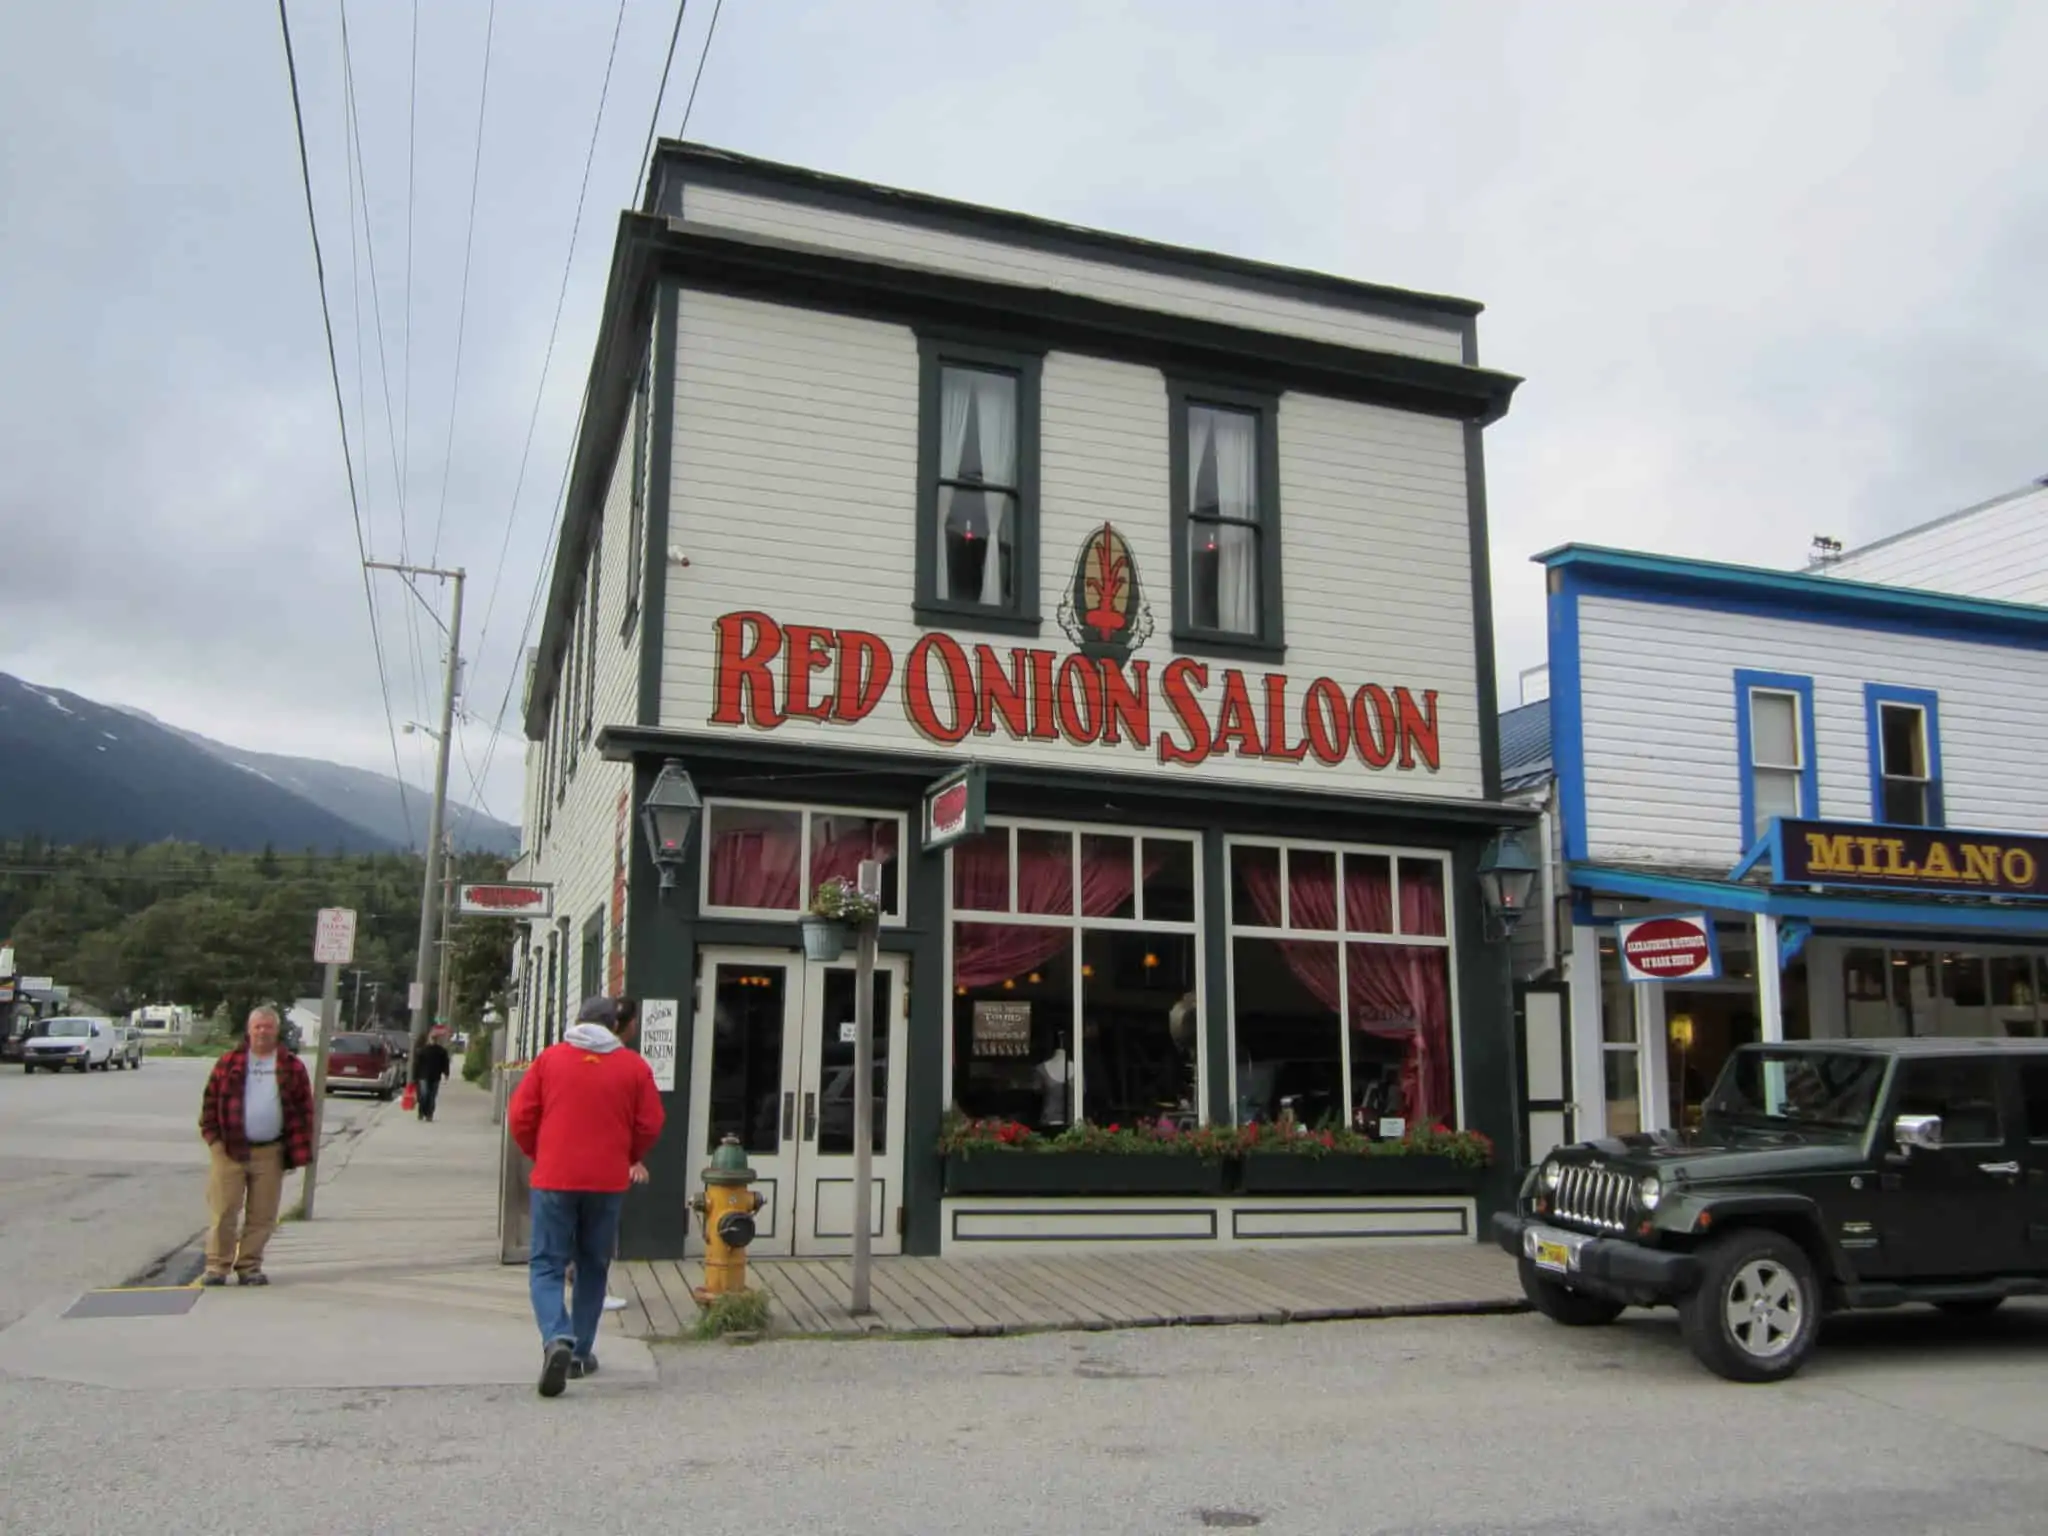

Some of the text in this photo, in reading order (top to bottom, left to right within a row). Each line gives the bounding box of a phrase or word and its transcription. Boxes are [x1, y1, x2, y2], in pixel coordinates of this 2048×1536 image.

[707, 610, 1440, 774] RED ONION SALOON
[1805, 833, 2035, 887] MILANO
